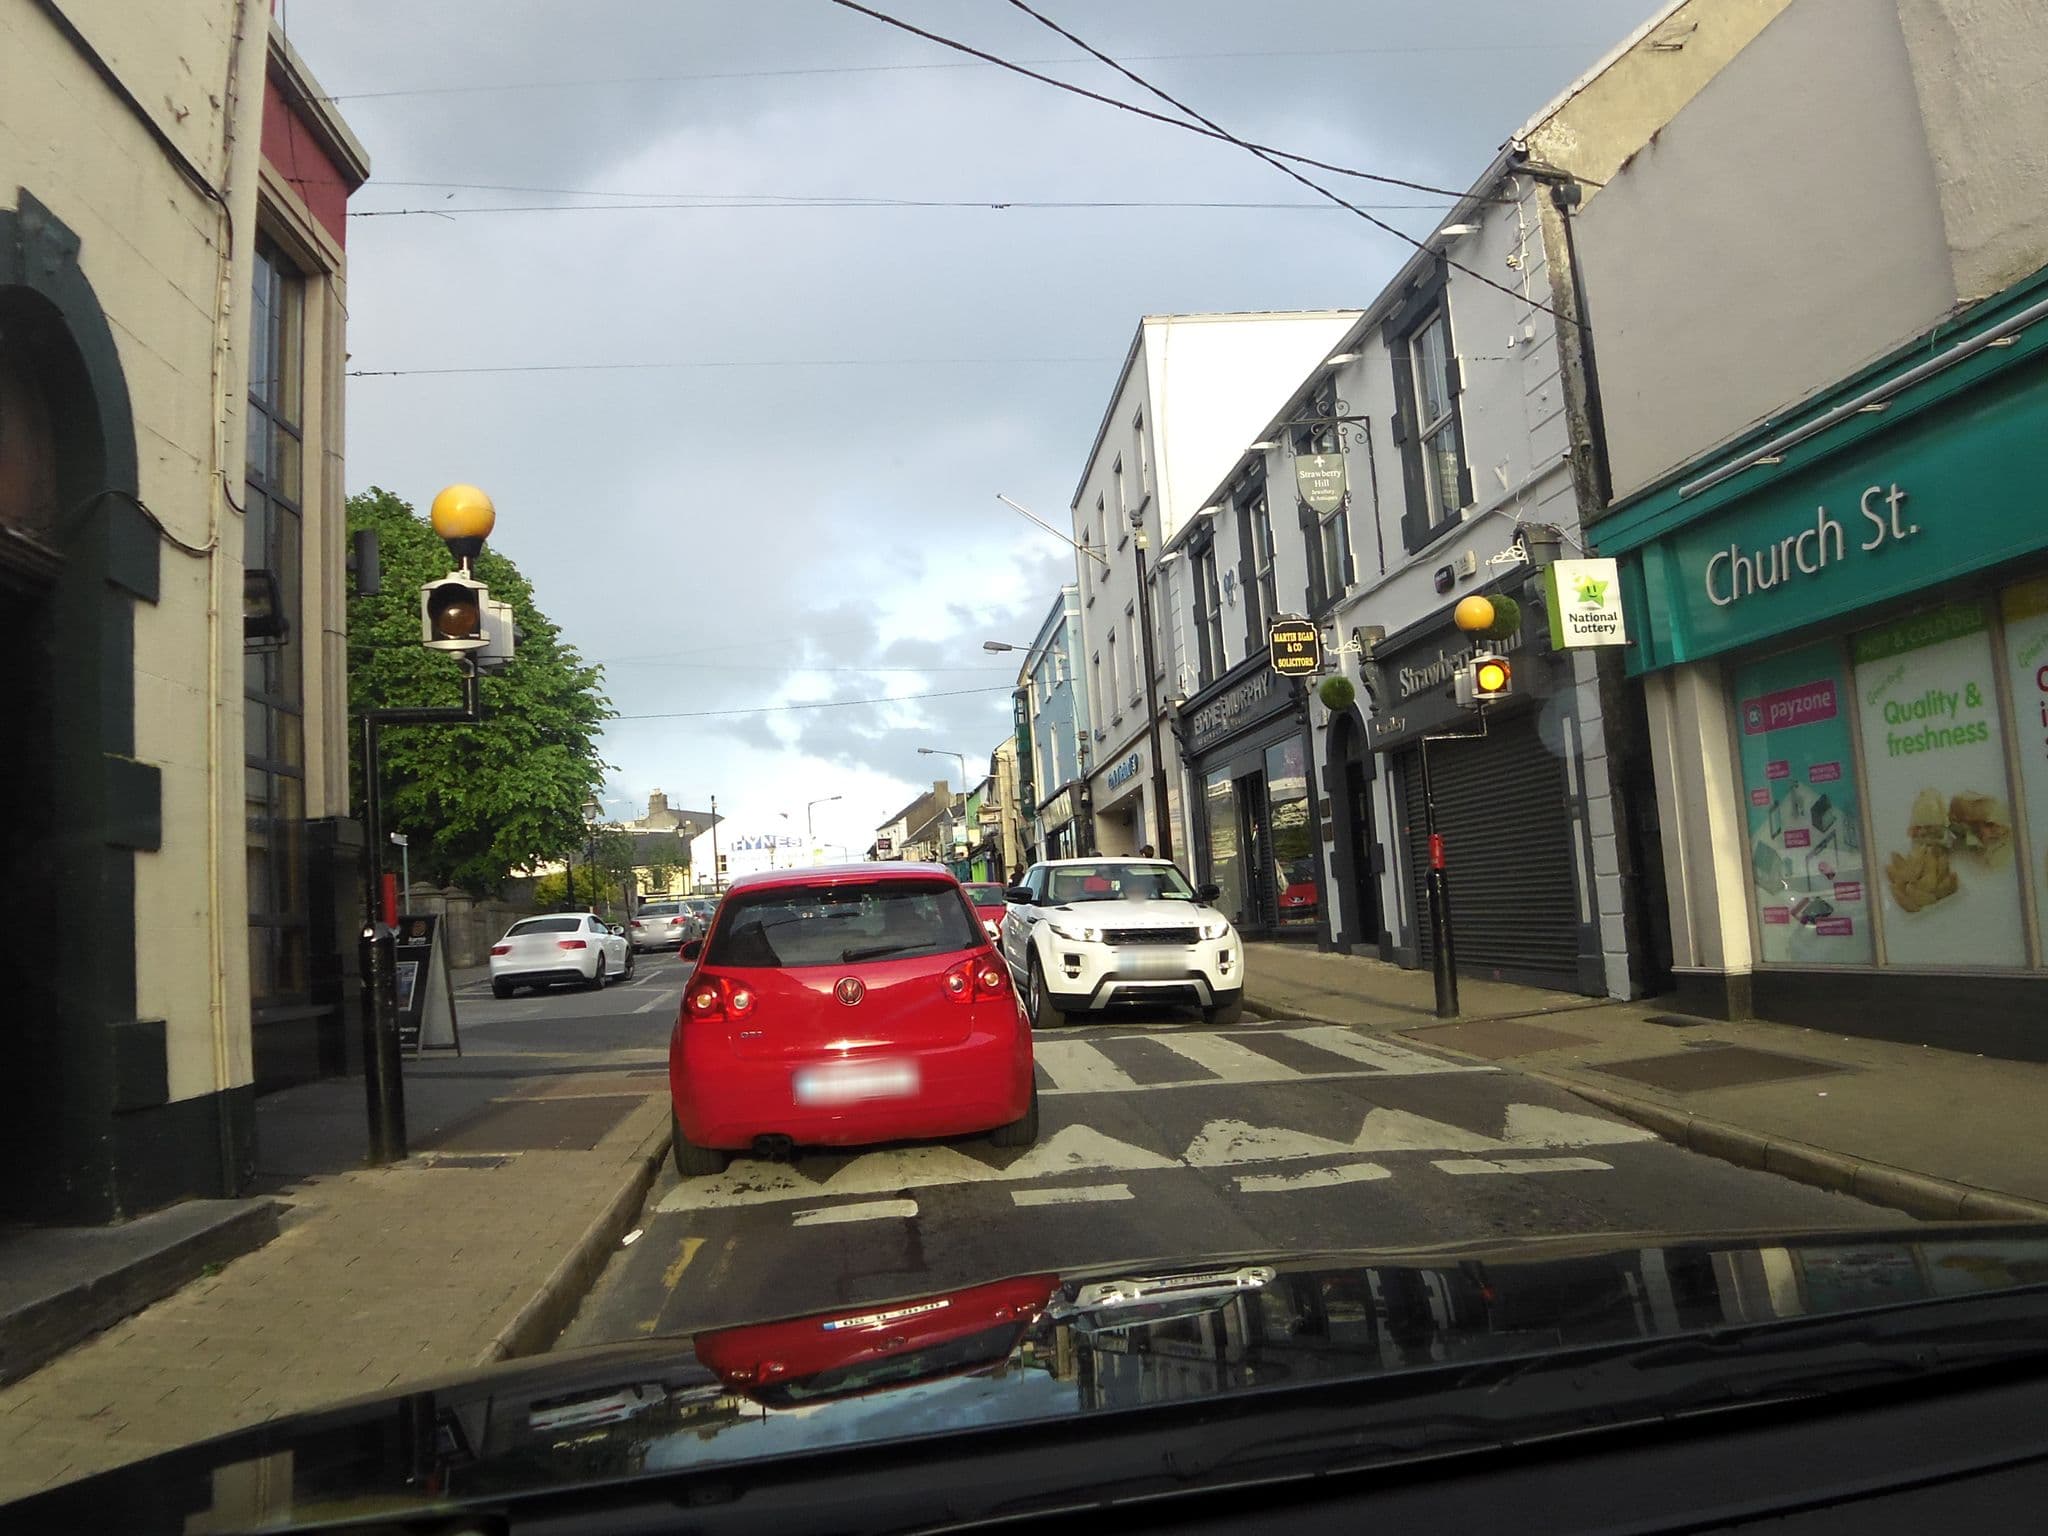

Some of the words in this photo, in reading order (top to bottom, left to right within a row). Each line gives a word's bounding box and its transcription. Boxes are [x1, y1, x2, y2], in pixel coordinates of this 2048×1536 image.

[1299, 469, 1342, 479] Strawberry
[1314, 478, 1330, 487] Hill
[1705, 505, 1845, 607] Church
[1860, 482, 1919, 552] St.
[1568, 611, 1618, 623] National
[1573, 623, 1616, 635] Lottery
[1273, 632, 1297, 643] MARTIN
[1287, 643, 1293, 652] &
[1293, 642, 1303, 652] CO
[1278, 657, 1314, 668] SOLICITORS
[1226, 671, 1268, 716] MURPHY
[1769, 691, 1831, 725] payzone
[1883, 689, 1959, 726] Quality
[1964, 681, 1984, 709] &
[1886, 720, 1990, 758] freshness
